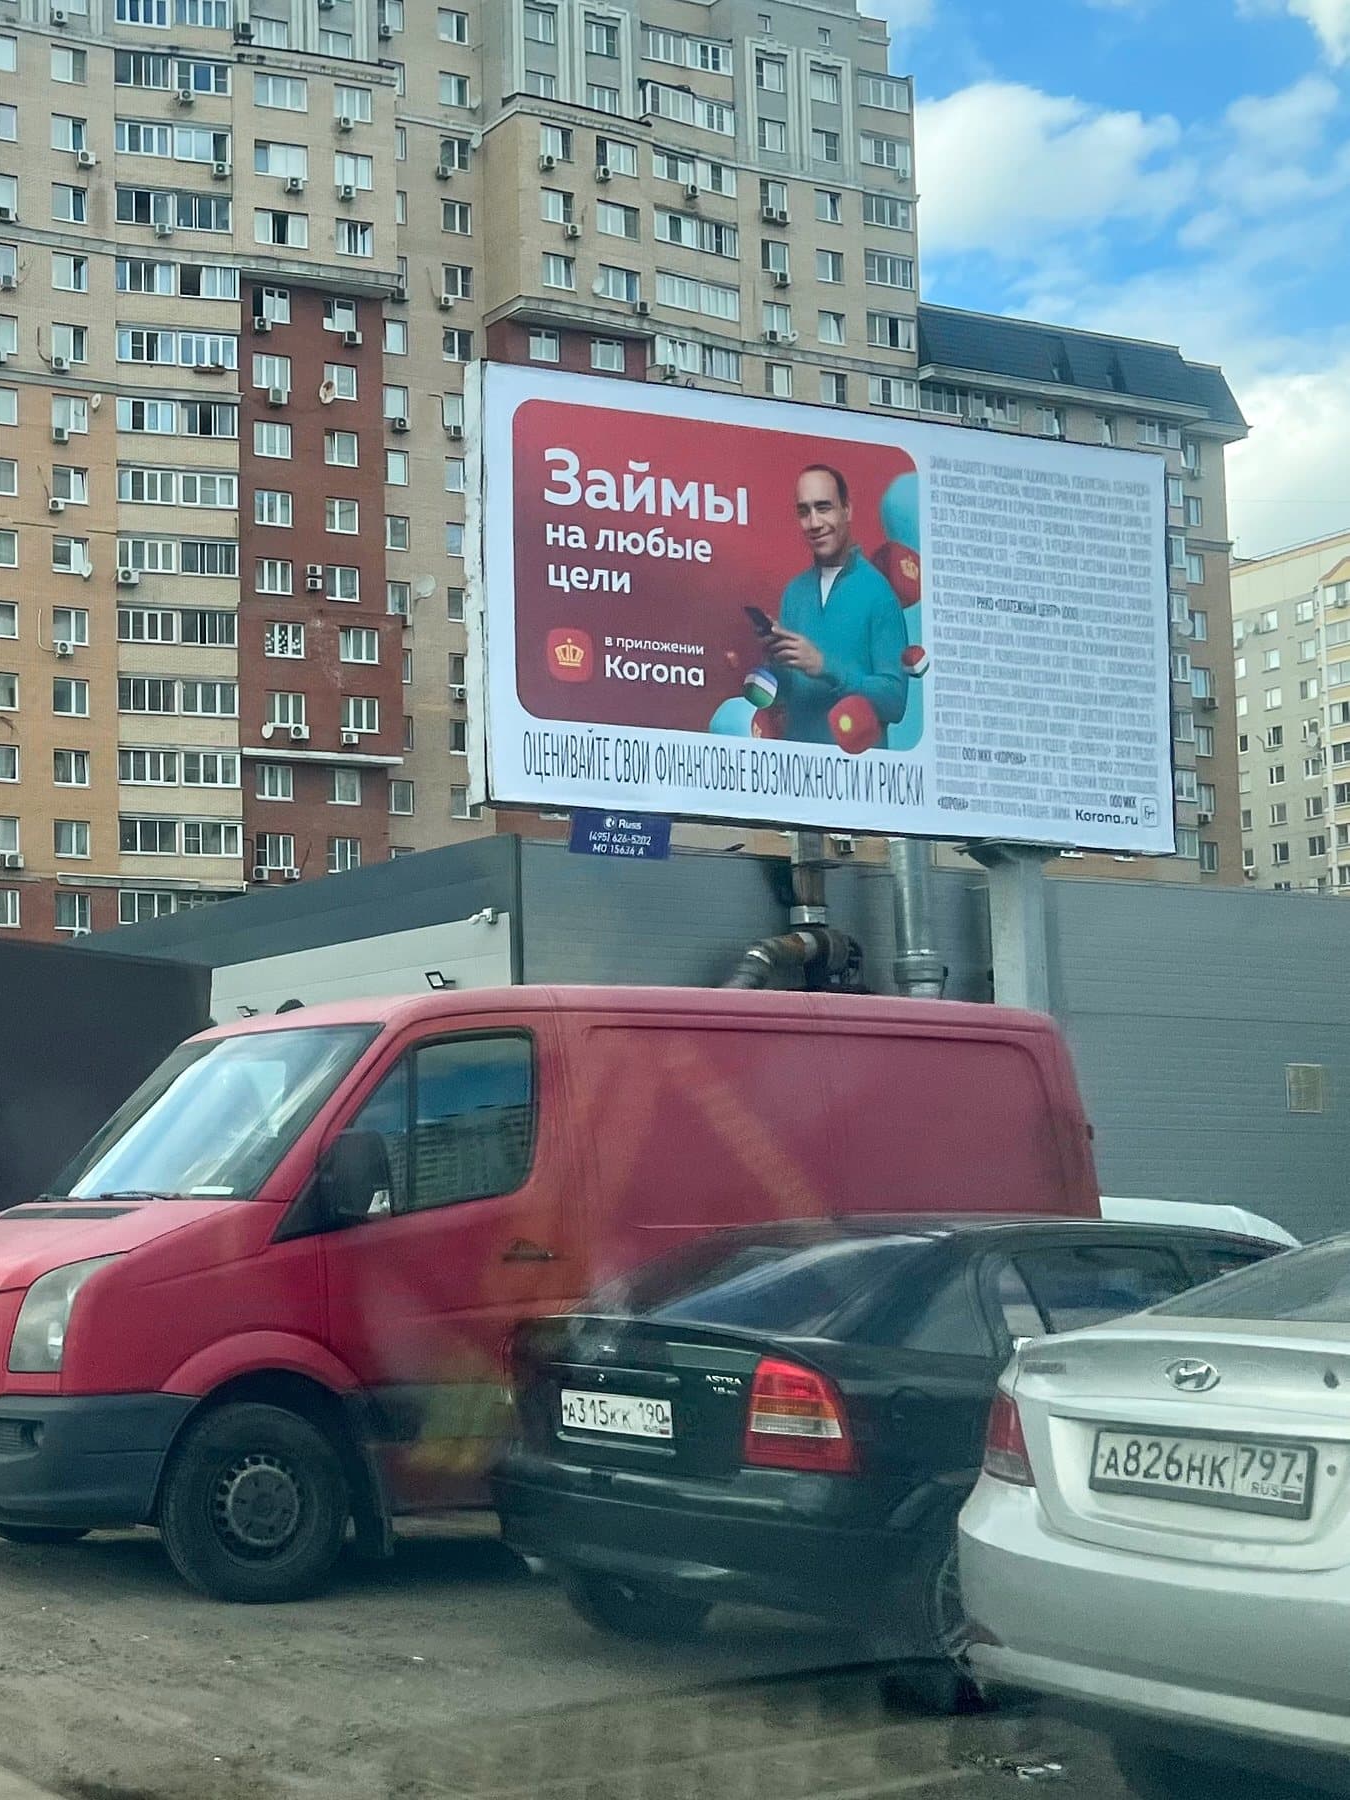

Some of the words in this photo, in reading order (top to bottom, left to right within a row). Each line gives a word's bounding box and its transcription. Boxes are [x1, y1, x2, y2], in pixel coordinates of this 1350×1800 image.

[544, 447, 748, 525] Займы
[546, 523, 588, 549] на
[594, 526, 713, 563] любые
[548, 564, 632, 593] цели
[605, 636, 613, 647] в
[616, 637, 704, 656] приложении
[605, 654, 705, 686] Korona
[523, 728, 610, 783] ОЦЕНИВАЙТЕ
[615, 738, 650, 784] СВОИ
[655, 741, 746, 792] ФИНАНСОВЫЕ
[751, 750, 860, 801] ВОЗМОЖНОСТИ
[865, 761, 874, 803] И
[879, 761, 925, 806] РИСКИ
[619, 819, 642, 830] Russ
[1075, 809, 1138, 825] Korona.ru
[589, 831, 610, 842] (495)
[706, 1375, 742, 1385] ASTRA
[638, 1401, 665, 1424] 190
[1103, 1439, 1230, 1489] А826НК
[1238, 1446, 1298, 1484] 797
[1251, 1481, 1280, 1498] RUS
